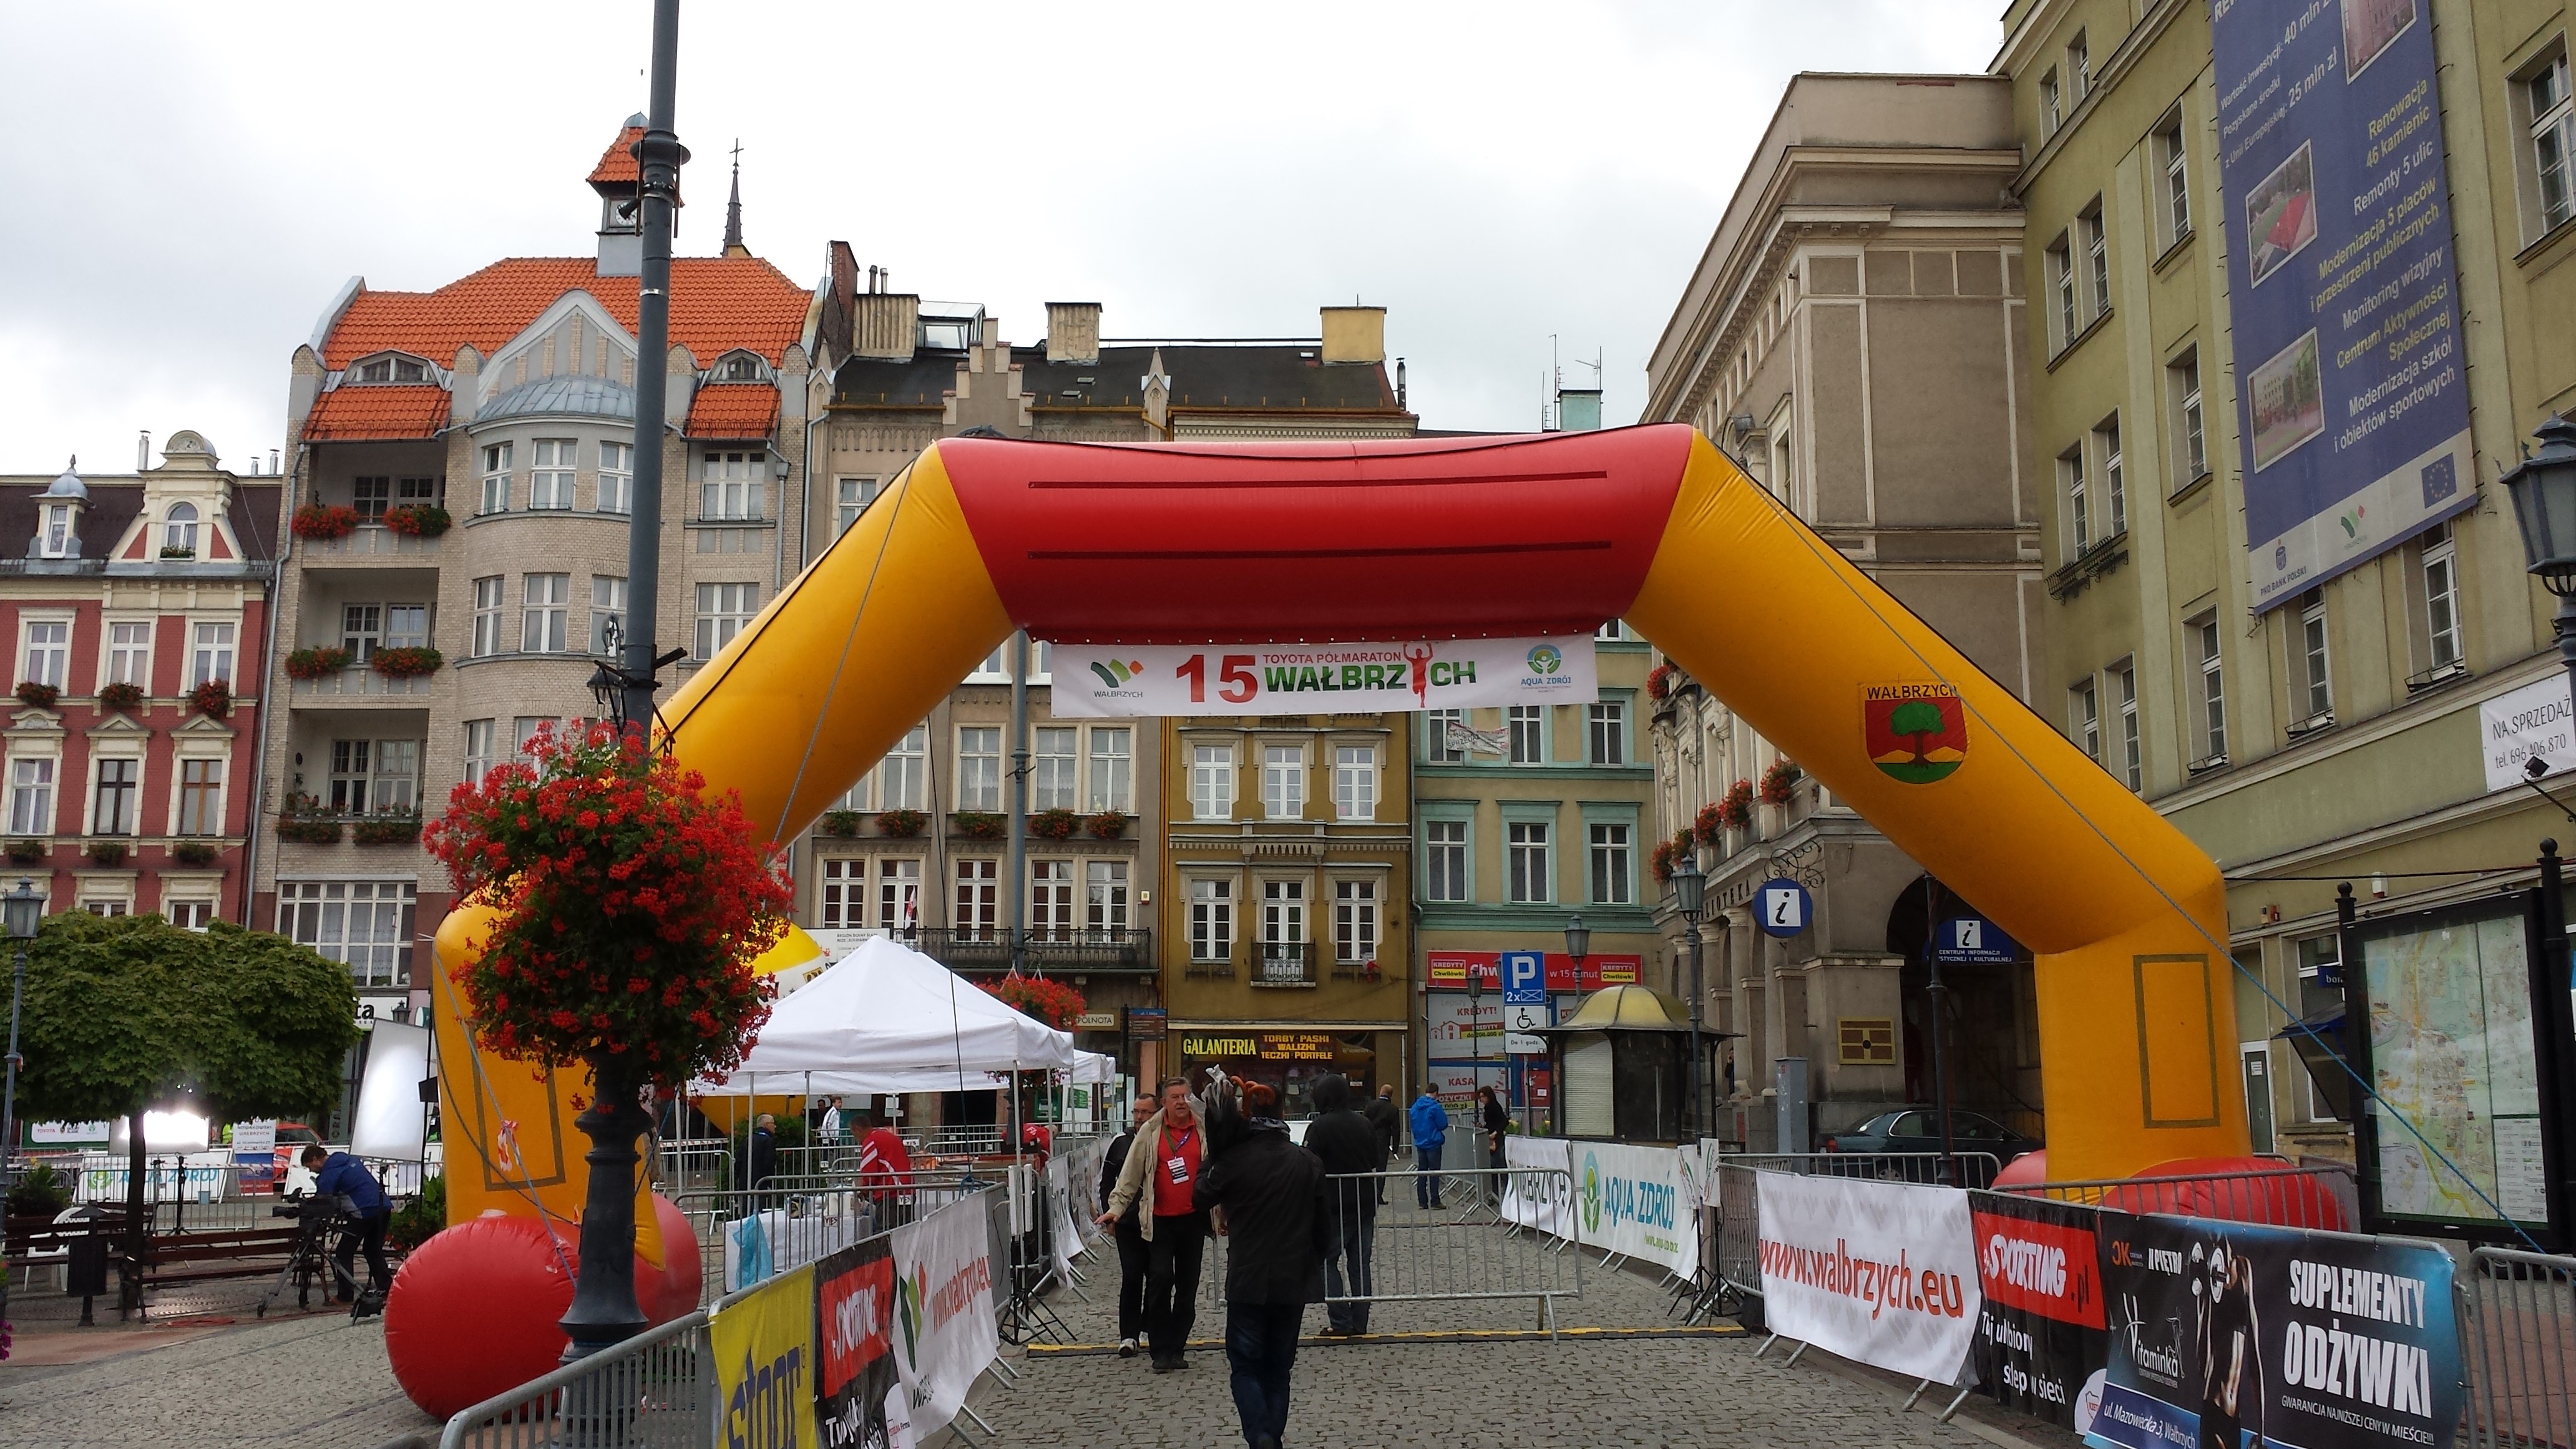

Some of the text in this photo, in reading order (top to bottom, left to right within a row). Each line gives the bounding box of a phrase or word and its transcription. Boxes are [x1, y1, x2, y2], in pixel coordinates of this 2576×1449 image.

[2221, 77, 2247, 110] Wartość
[2284, 21, 2297, 44] 40
[2300, 1, 2320, 31] mln
[2223, 75, 2281, 139] Pozyskane środki
[2230, 143, 2243, 163] Unii
[2288, 81, 2301, 108] 25
[2304, 65, 2325, 92] mln
[2327, 46, 2337, 71] zł
[2368, 79, 2427, 140] Renowacja
[2366, 106, 2430, 168] 46 kamienic
[2353, 140, 2433, 216] Remonty 5 ulic
[2319, 177, 2436, 280] Modernizacja 5 placów
[2310, 203, 2439, 313] i przestrzeni publicznych
[2343, 246, 2443, 331] Monitoring wizyjny
[2336, 278, 2447, 369] Centrum Aktywności
[2389, 305, 2451, 362] Społecznej
[2349, 334, 2452, 417] Modernizacja szkół
[2334, 365, 2456, 454] i obiektów sportowych
[2271, 576, 2286, 592] BANK
[2287, 565, 2307, 583] POLSKI
[1176, 654, 1259, 703] 15
[1263, 651, 1402, 665] TOYOTA PÓŁMARATON
[1521, 675, 1571, 686] AQUA ZDRÓJ
[1867, 683, 1958, 700] WAŁBRZYCH
[2492, 694, 2572, 741] NA SPRZEDAŻ
[2496, 733, 2566, 769] tel. 696 406 870
[1701, 879, 1750, 920] LIOTEKA
[1511, 955, 1536, 989] P
[1560, 969, 1570, 978] 15
[1457, 1007, 1497, 1016] KREDYT!
[1183, 1038, 1257, 1055] GALANTERIA
[1261, 1051, 1333, 1060] TECZKI PORTFELE
[1263, 1035, 1330, 1043] TORBY PASKI
[1448, 1078, 1475, 1086] KASA
[899, 1196, 911, 1204] YES
[1604, 1176, 1634, 1227] AQUA
[1637, 1169, 1675, 1231] ZDRÓJ
[1760, 1237, 1964, 1320] www.walbrzych.eu
[2154, 1249, 2182, 1277] PIĘTRO
[2290, 1259, 2426, 1329] SUPLEMENTY
[2121, 1292, 2178, 1378] Vitaminka
[2039, 1373, 2066, 1405] sieci
[2284, 1318, 2432, 1419] ODŻYWKI
[2104, 1402, 2113, 1418] ul.
[2155, 1420, 2164, 1439] 3,
[2281, 1395, 2435, 1446] GWARANCJA NAJNIŻSZEJ CENY W MIEŚCIE!!!
